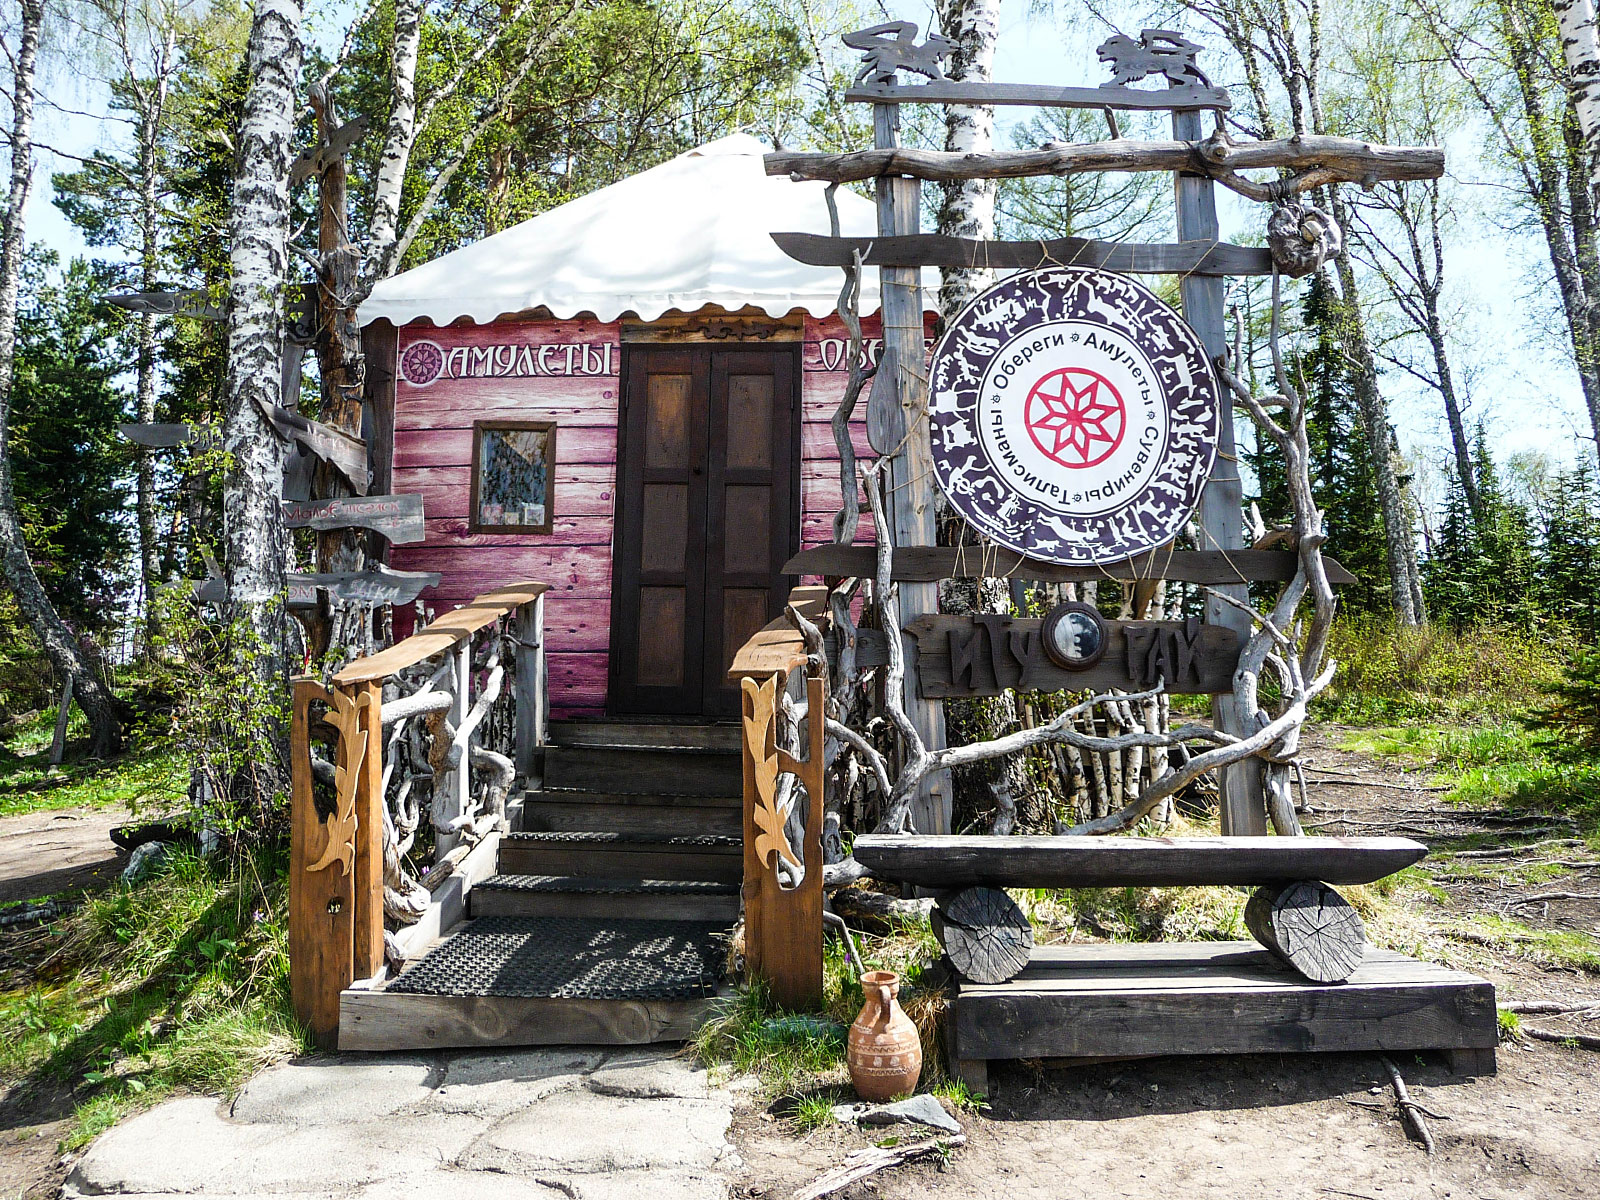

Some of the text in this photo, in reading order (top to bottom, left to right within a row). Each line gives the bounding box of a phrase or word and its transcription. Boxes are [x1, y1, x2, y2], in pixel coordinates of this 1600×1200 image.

[447, 342, 613, 378] АМУЛЕТЫ
[993, 333, 1065, 389] Обереги
[1083, 332, 1154, 406] Амулеты
[990, 409, 1071, 505] Талисманы
[1084, 426, 1159, 502] Сувениры
